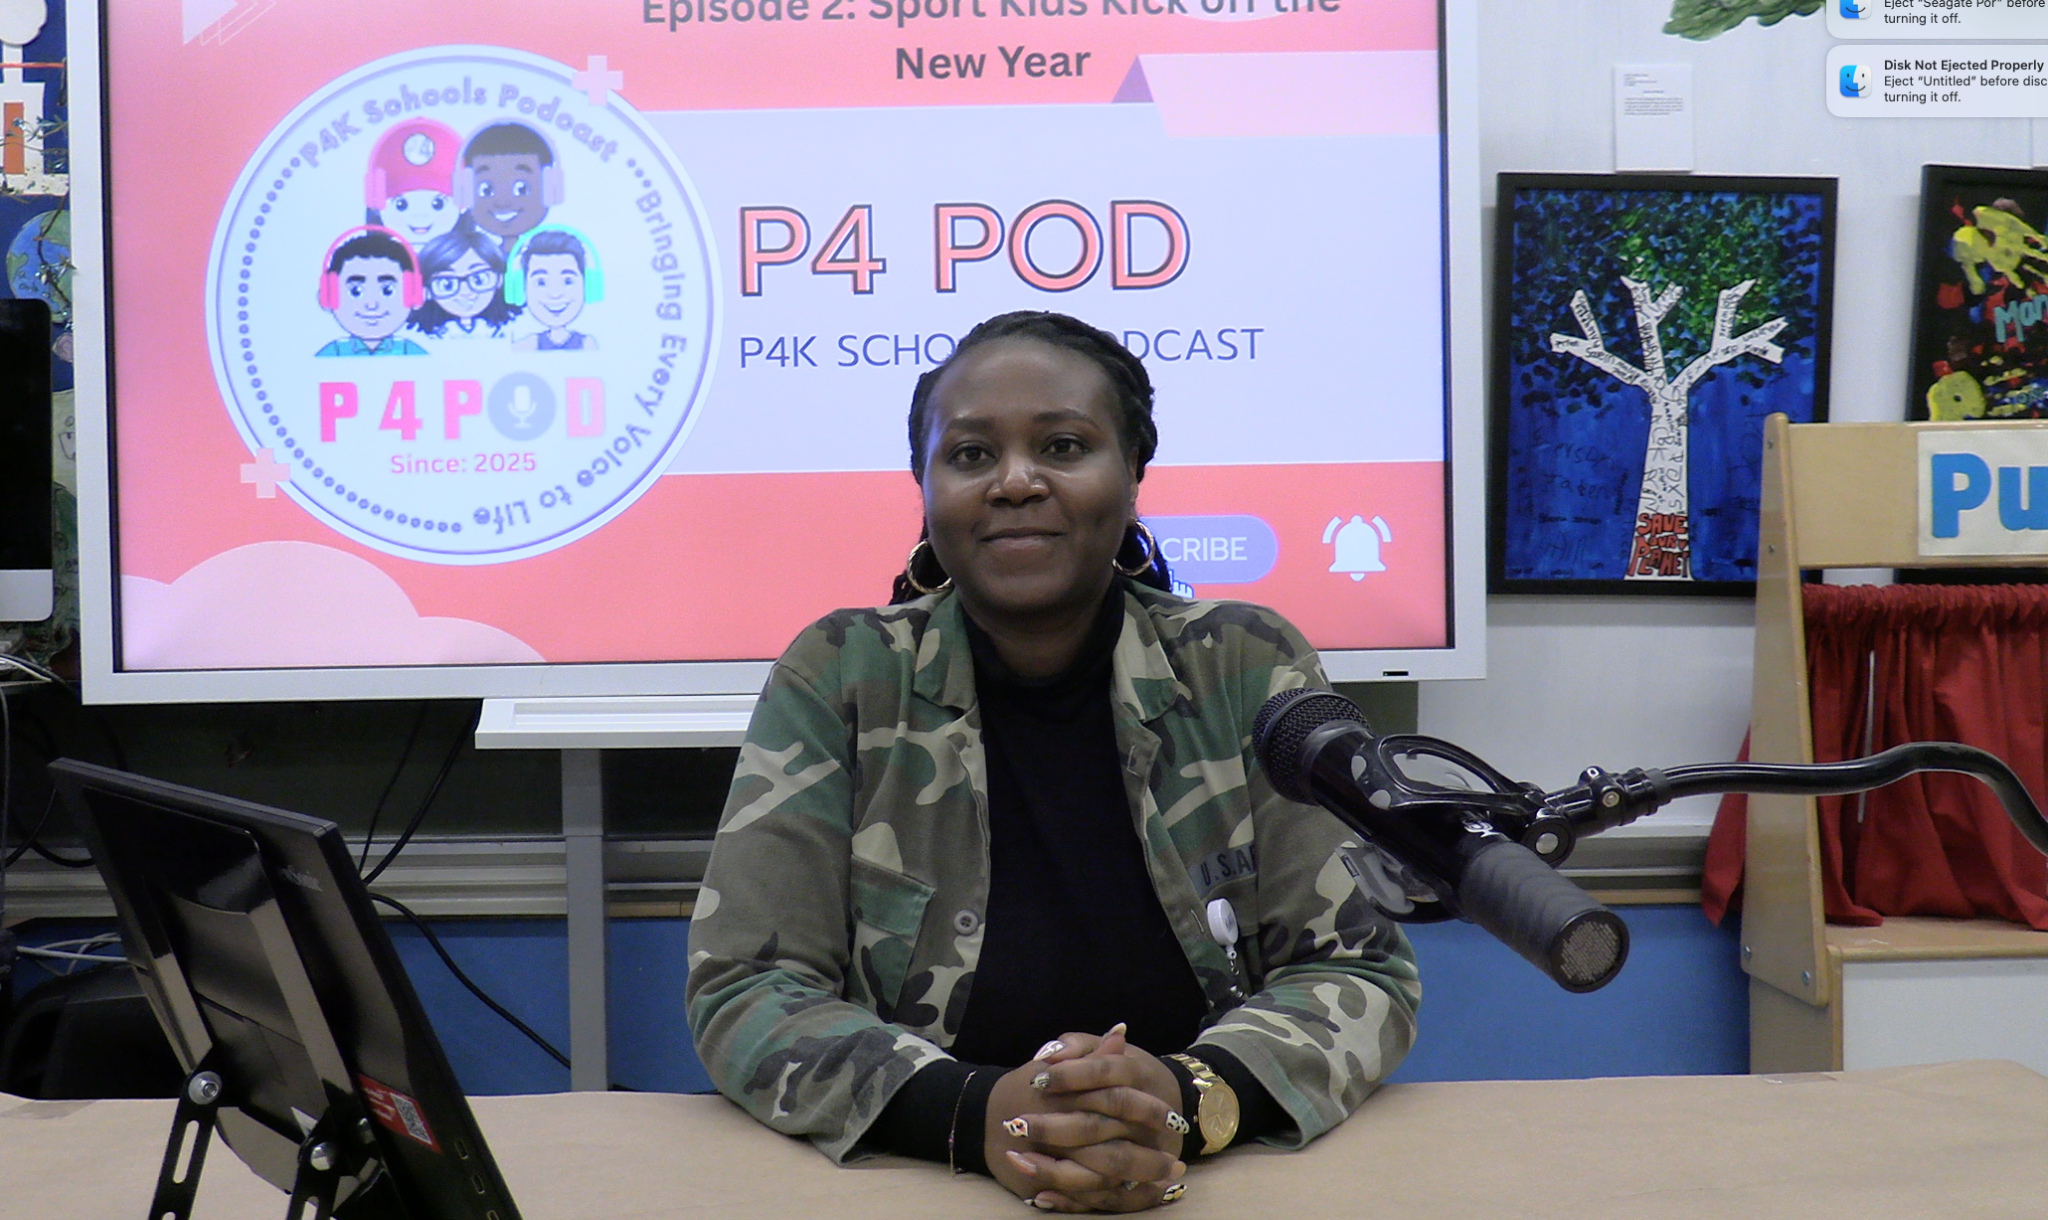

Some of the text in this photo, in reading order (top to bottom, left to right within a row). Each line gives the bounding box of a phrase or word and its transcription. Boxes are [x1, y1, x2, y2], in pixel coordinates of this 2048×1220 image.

[642, 0, 809, 32] Episode
[868, 0, 986, 28] Sport
[896, 45, 1092, 80] New Year
[299, 76, 618, 169] P4K Schools Podcast
[739, 199, 1191, 297] P4 POD
[740, 328, 1265, 368] P4K SCHO DCAST
[634, 333, 687, 417] Every
[390, 453, 537, 474] Since: 2025
[539, 485, 572, 508] to
[1931, 453, 2048, 538] Pu
[1635, 512, 1689, 536] SAVE
[1160, 536, 1248, 562] CRIBE
